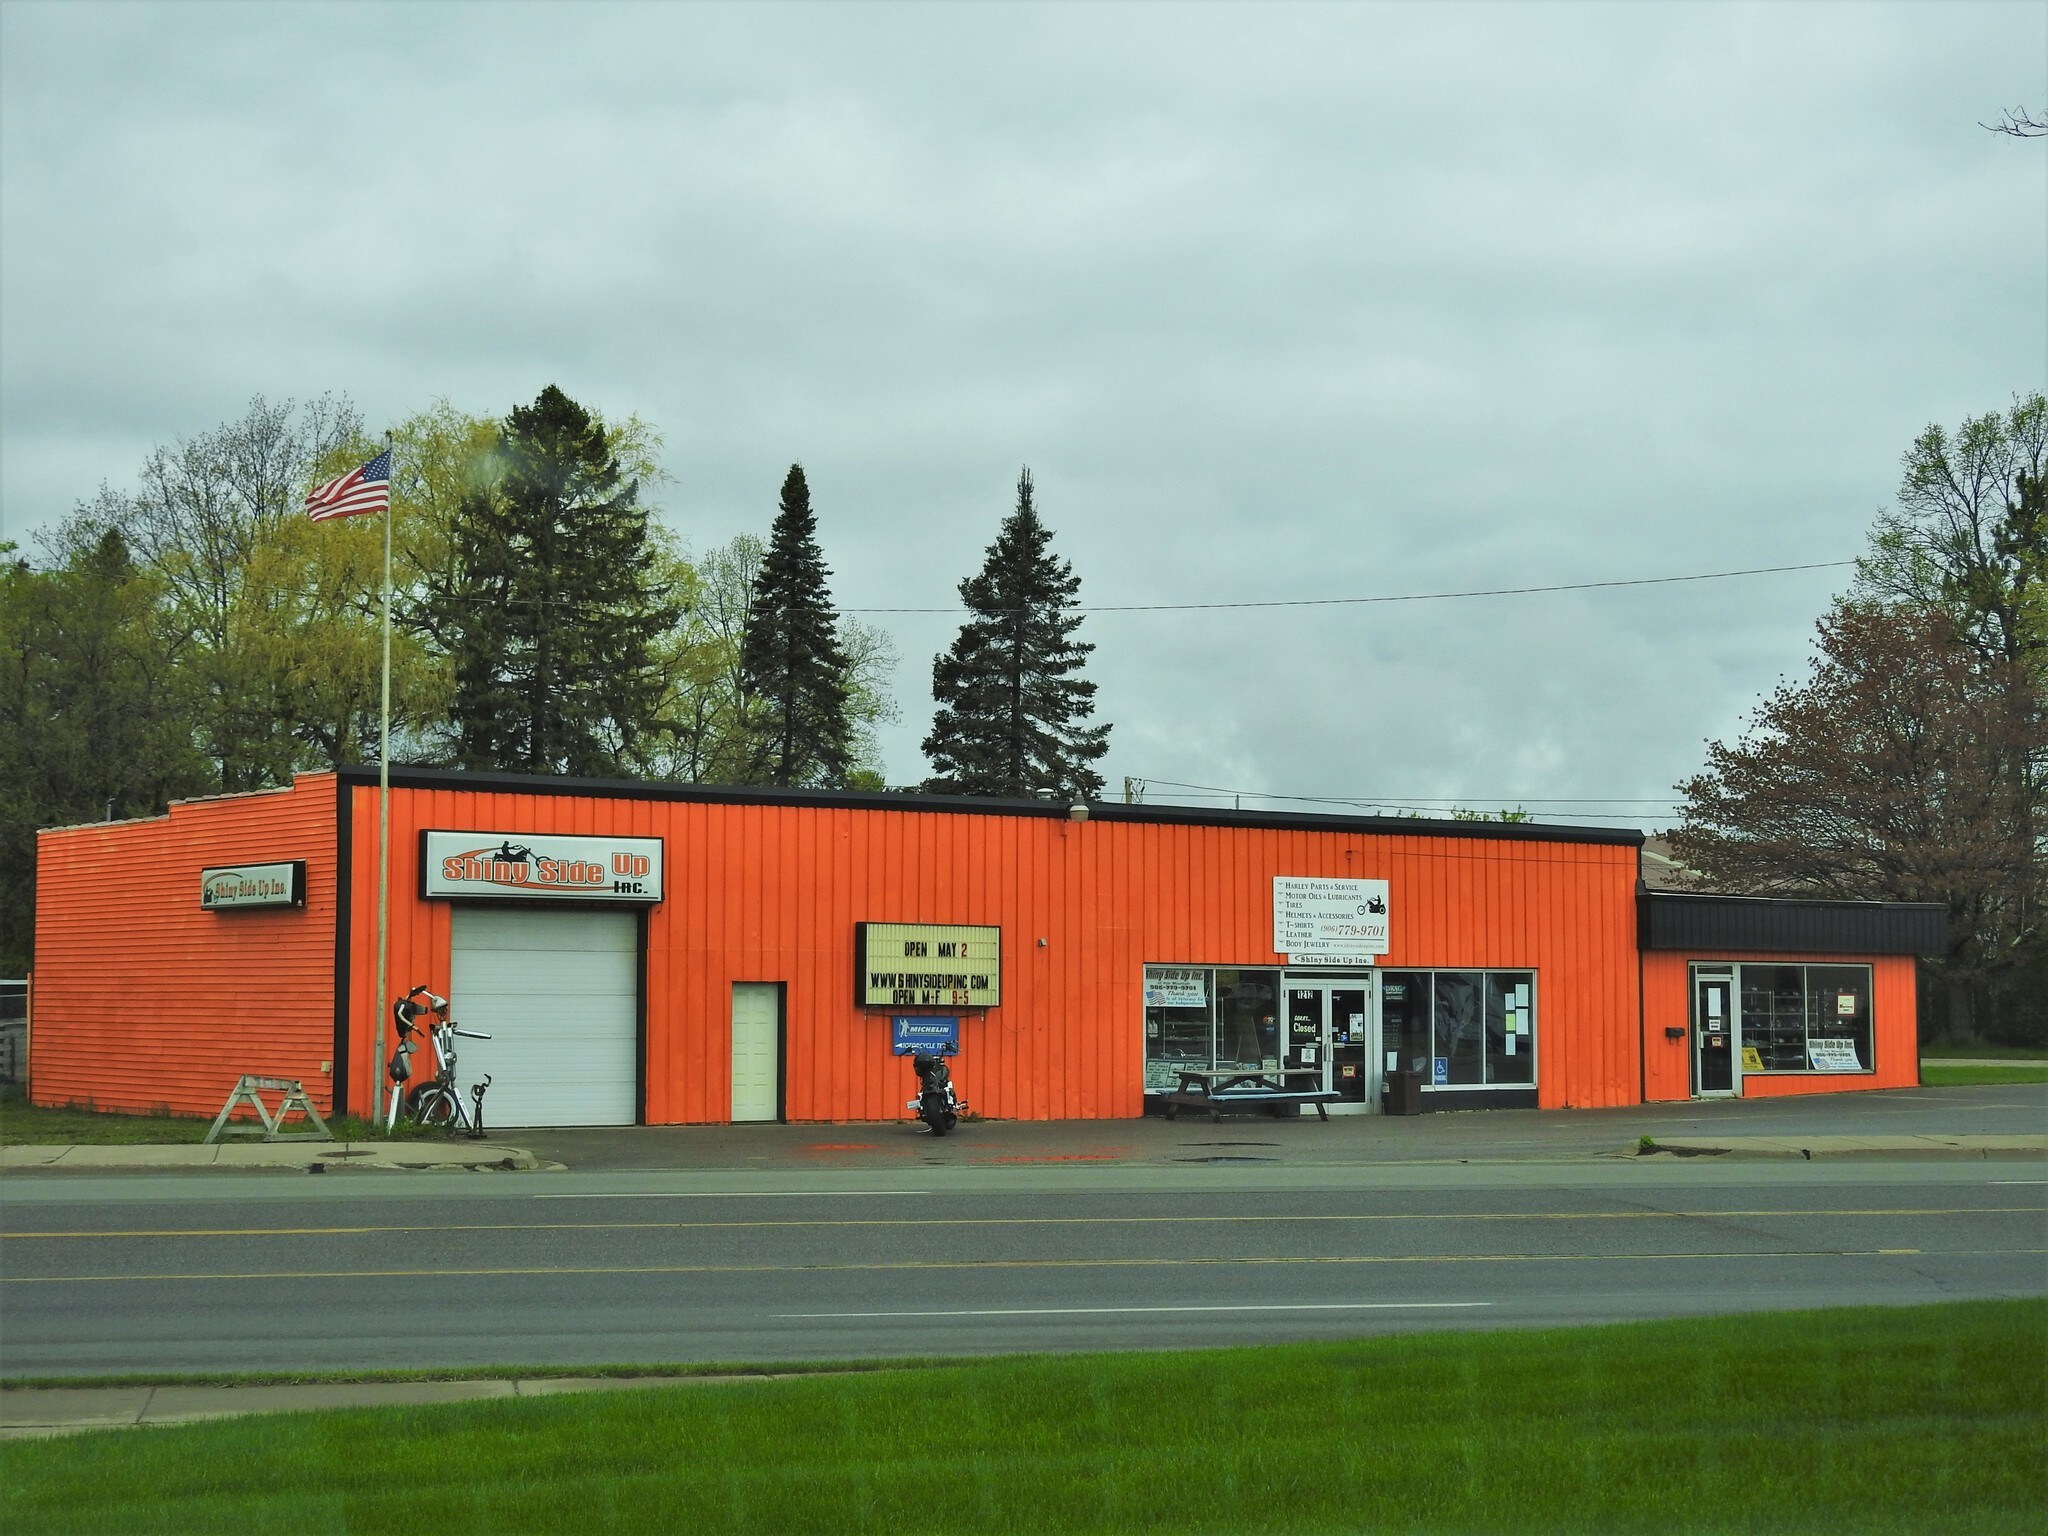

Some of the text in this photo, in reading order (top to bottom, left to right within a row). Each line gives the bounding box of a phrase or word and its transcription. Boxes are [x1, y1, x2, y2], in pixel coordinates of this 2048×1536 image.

[443, 853, 650, 884] Shiny Side Up
[215, 882, 238, 901] Shiny
[239, 879, 256, 897] Side
[259, 880, 269, 899] Up
[904, 942, 967, 957] OPEN MAY 2
[1301, 956, 1322, 964] Shiny
[1343, 956, 1353, 964] Up
[892, 990, 969, 1005] OPEN M-F 9-5
[1293, 1022, 1316, 1033] Closed
